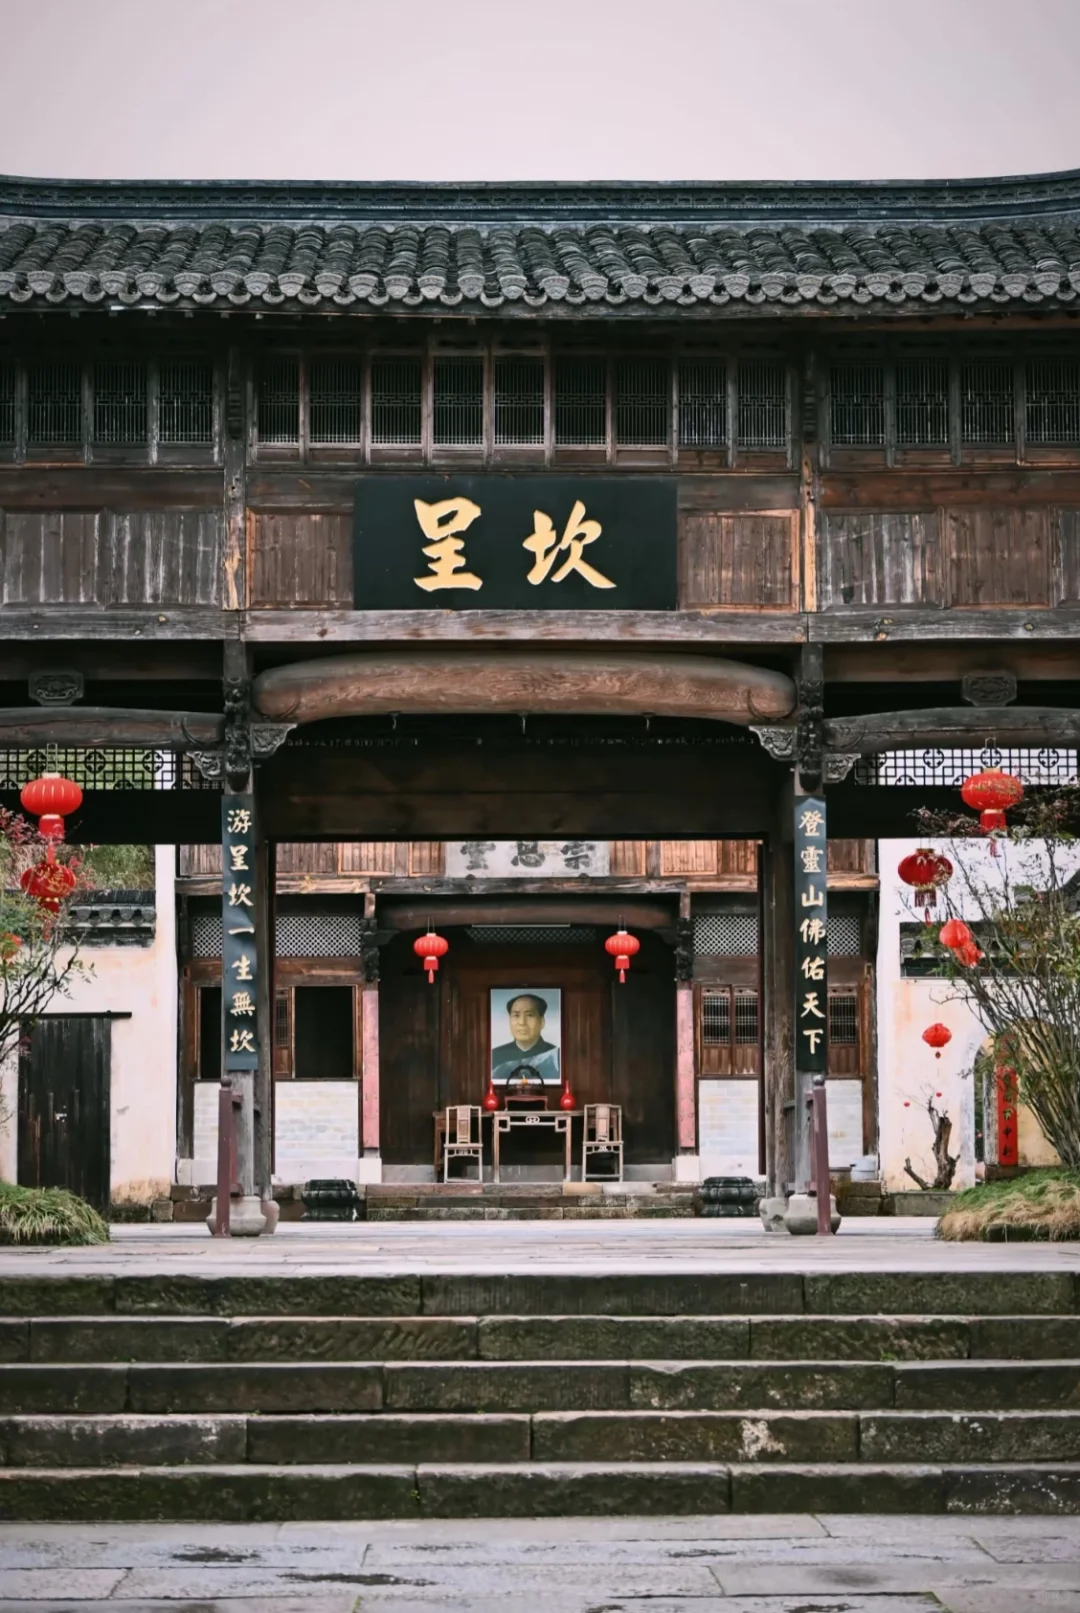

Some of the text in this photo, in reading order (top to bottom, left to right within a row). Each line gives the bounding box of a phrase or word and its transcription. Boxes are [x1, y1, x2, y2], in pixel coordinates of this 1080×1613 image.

[413, 496, 617, 592] 呈坎
[227, 809, 256, 1053] 游呈坎一生無坎
[798, 810, 826, 1055] 登靈山佛佑天下
